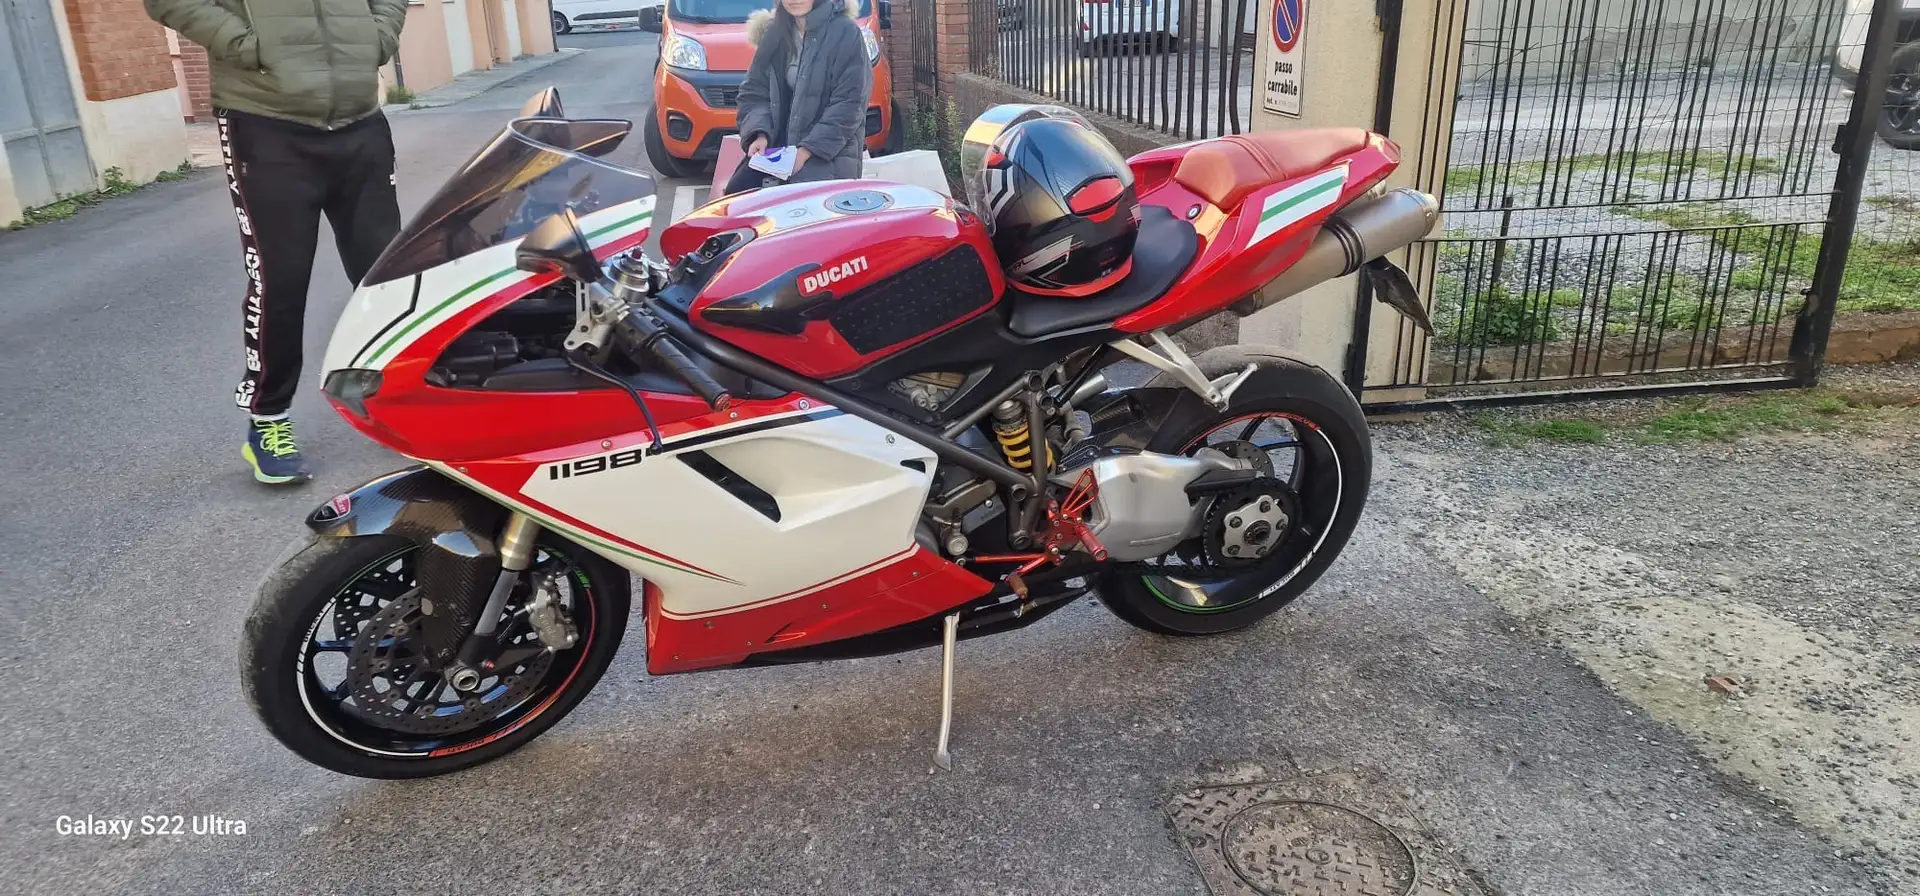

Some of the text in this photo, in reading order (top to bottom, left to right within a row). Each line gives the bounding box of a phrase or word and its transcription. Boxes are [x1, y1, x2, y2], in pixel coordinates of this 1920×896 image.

[1275, 61, 1292, 76] passo
[1268, 79, 1297, 95] carrabile
[803, 256, 868, 293] DUCATI
[550, 449, 642, 480] 1198
